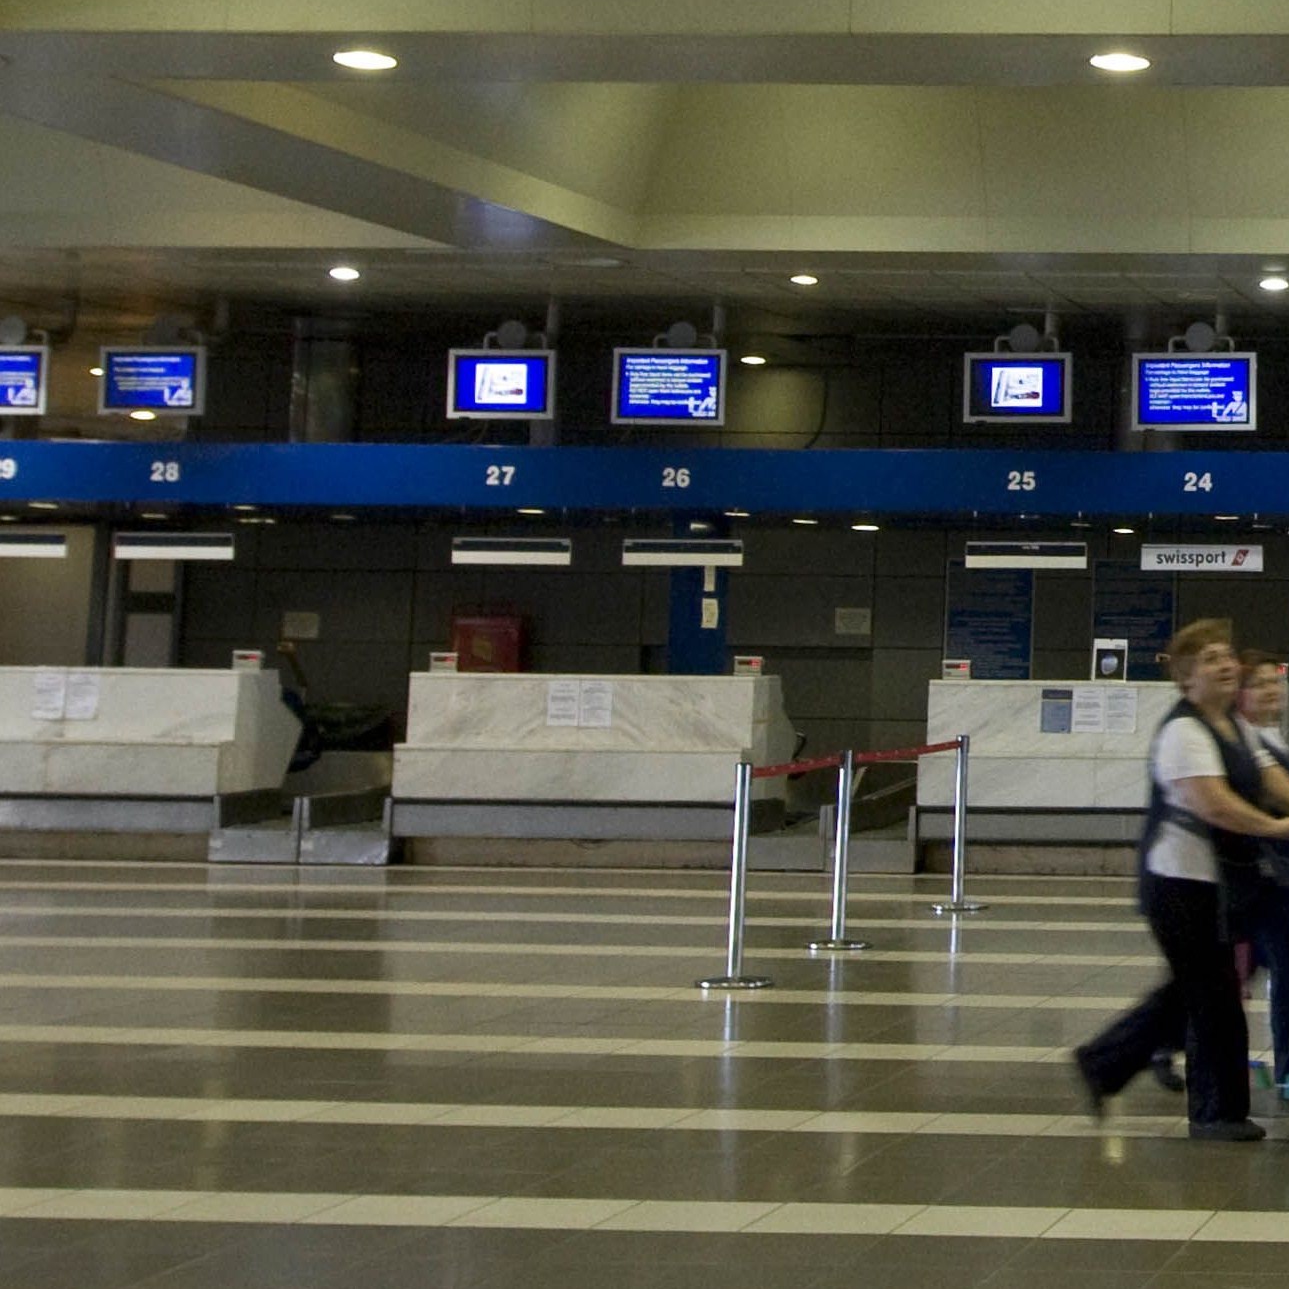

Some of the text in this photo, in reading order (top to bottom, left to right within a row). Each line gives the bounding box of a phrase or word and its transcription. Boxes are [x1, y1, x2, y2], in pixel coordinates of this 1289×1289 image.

[0, 458, 17, 479] 9
[150, 461, 180, 482] 28
[486, 466, 515, 487] 27
[662, 467, 690, 488] 26
[1007, 471, 1036, 491] 25
[1184, 472, 1212, 492] 24
[1156, 550, 1226, 567] swissport
